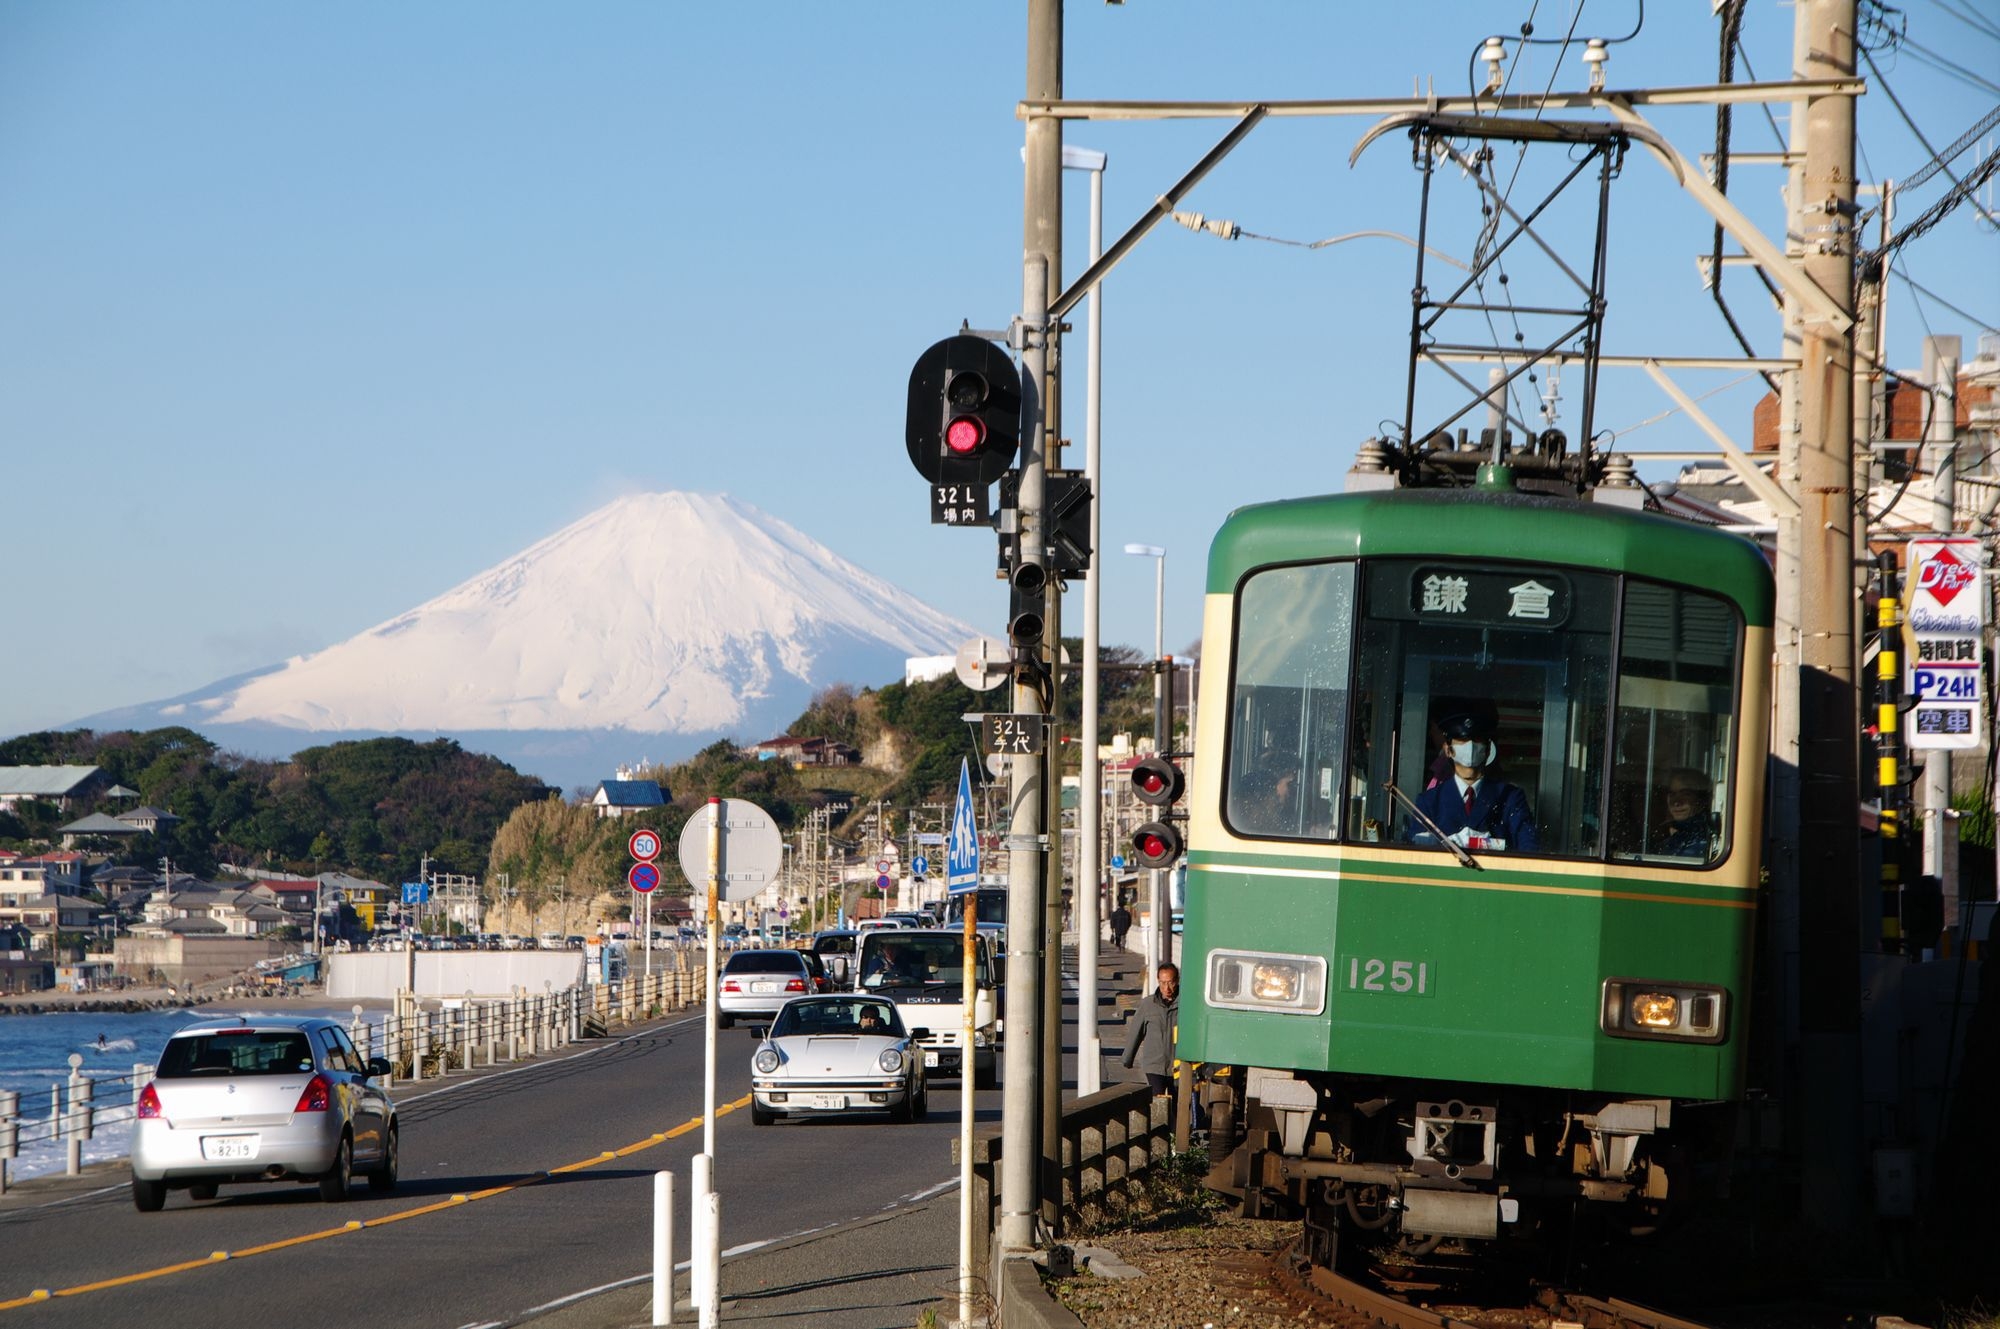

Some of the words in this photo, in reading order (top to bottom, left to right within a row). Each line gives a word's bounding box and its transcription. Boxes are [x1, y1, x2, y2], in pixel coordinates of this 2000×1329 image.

[1916, 559, 1977, 589] Direct
[1940, 574, 1972, 590] Park
[1917, 639, 1976, 661] 時間貸
[1937, 676, 1976, 697] 24H
[1918, 709, 1970, 733] 空車
[636, 838, 654, 853] 50
[1350, 958, 1426, 994] 1251
